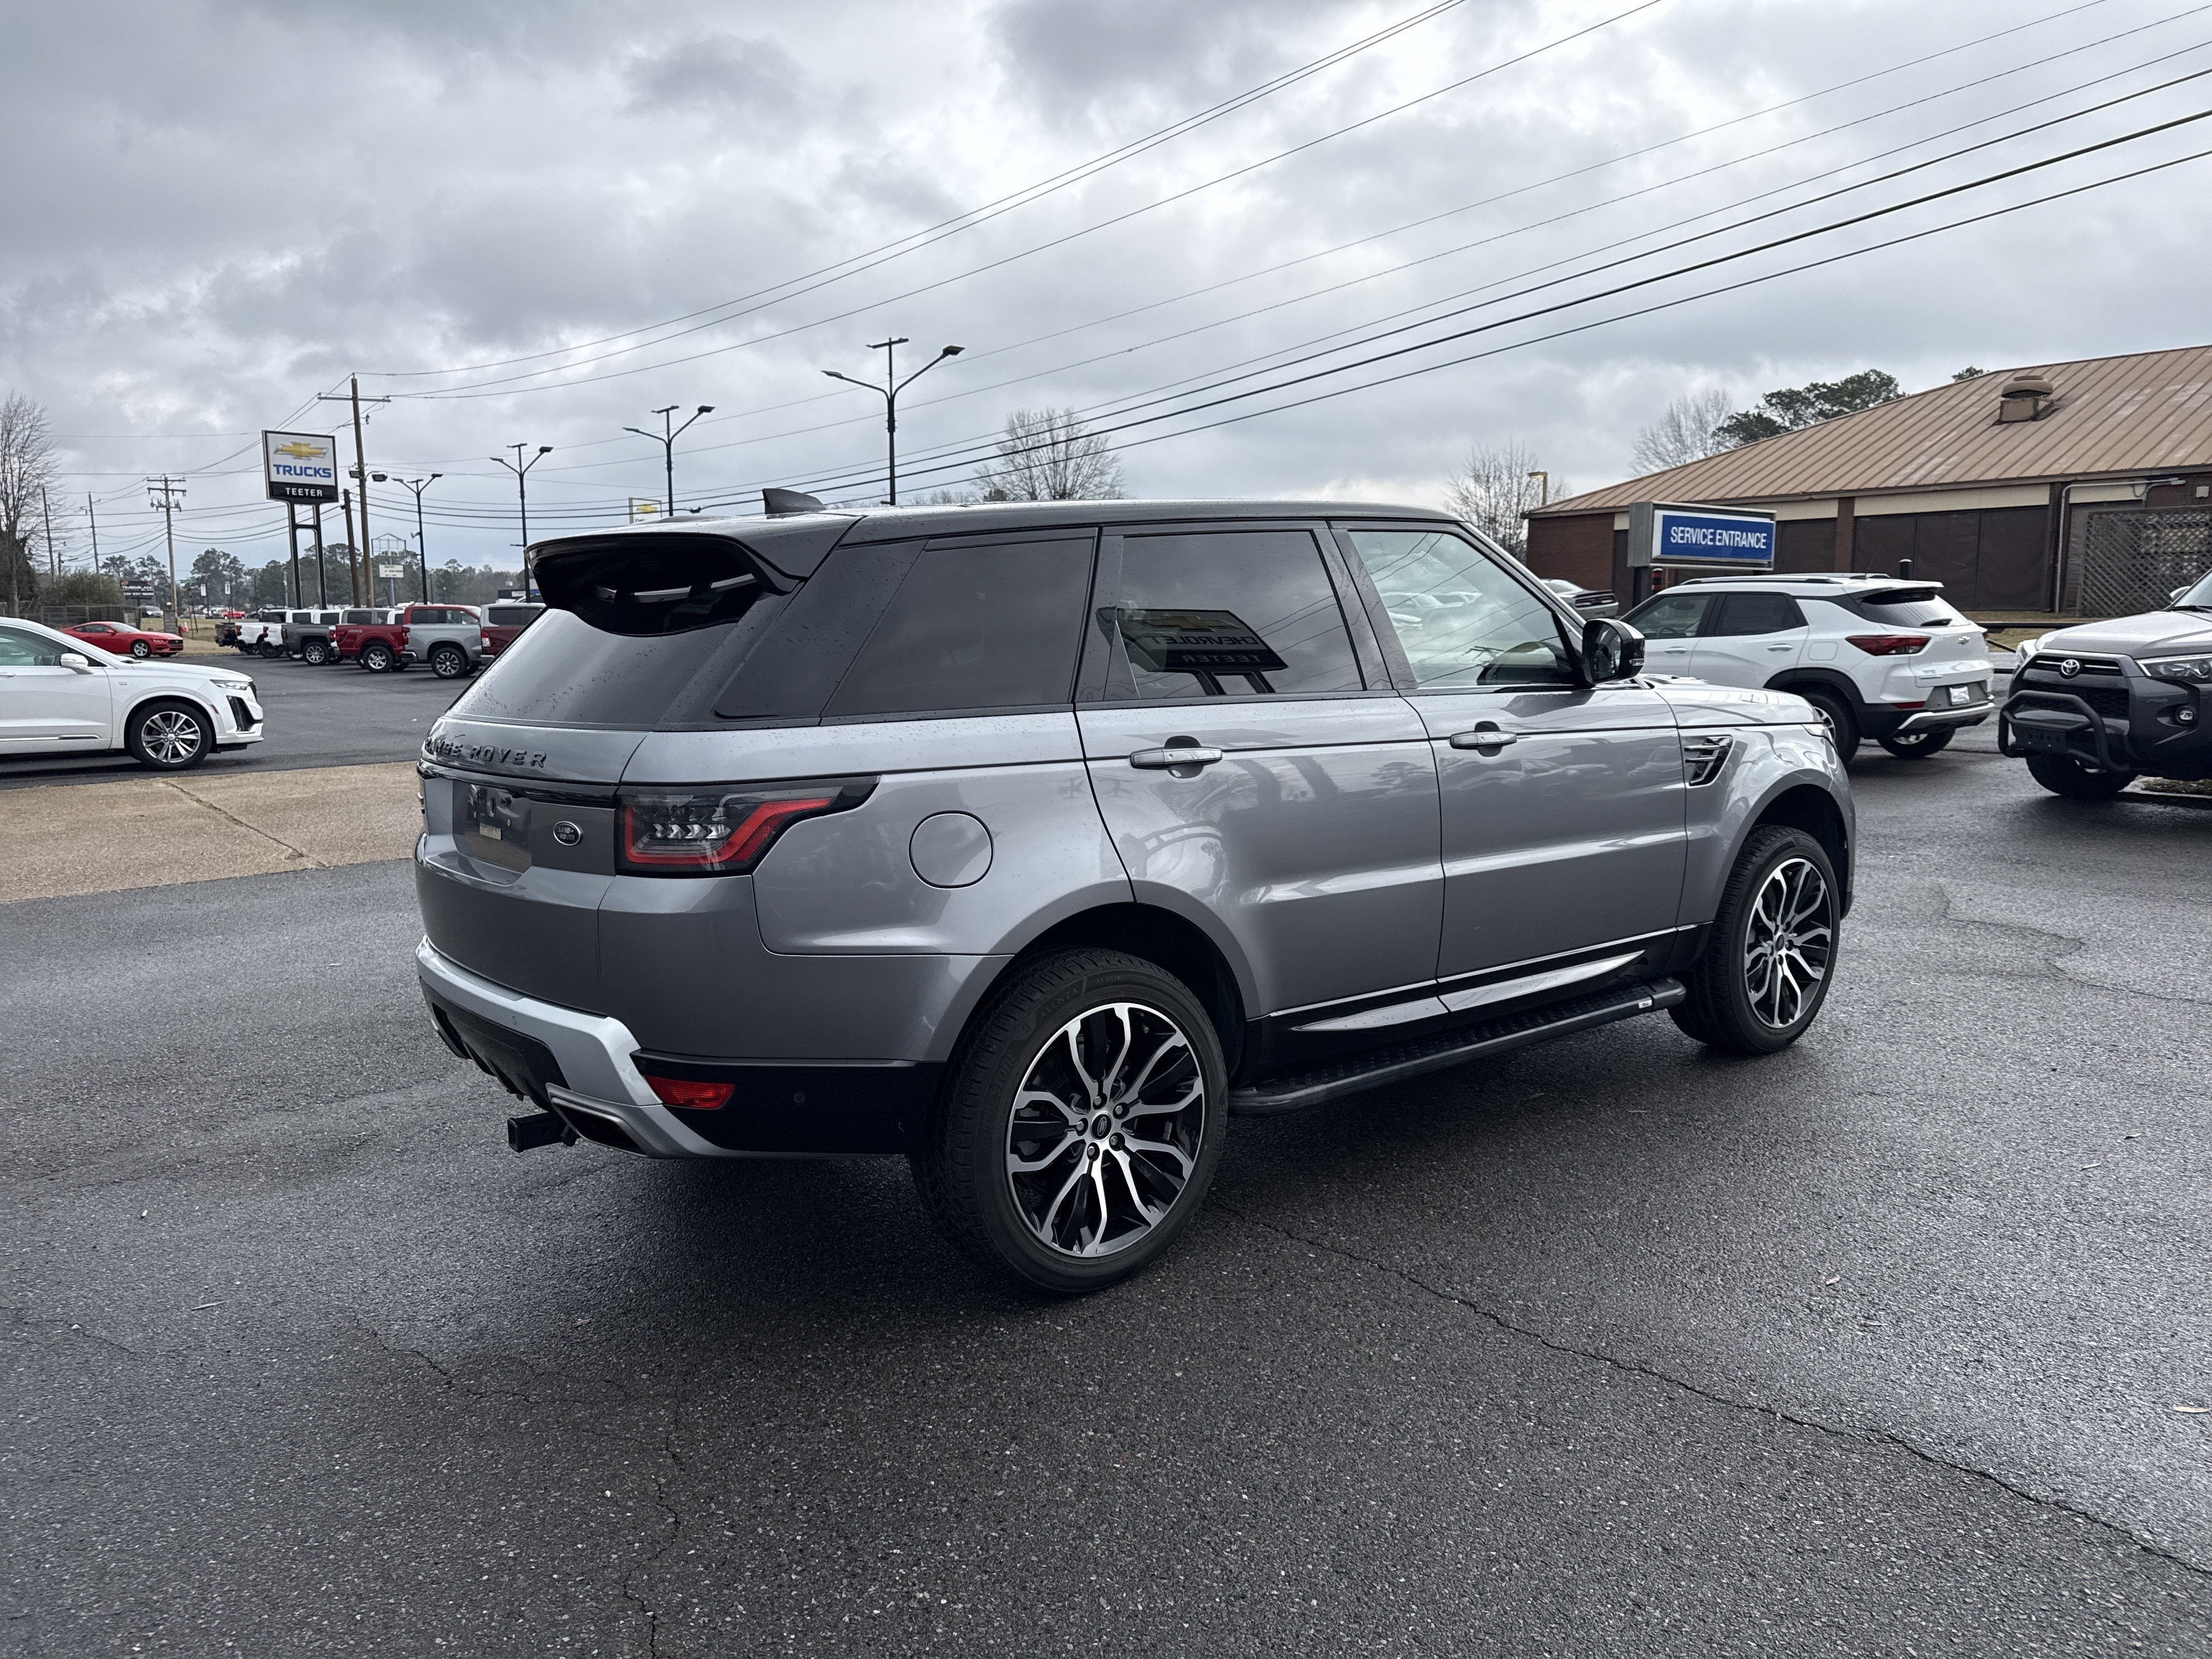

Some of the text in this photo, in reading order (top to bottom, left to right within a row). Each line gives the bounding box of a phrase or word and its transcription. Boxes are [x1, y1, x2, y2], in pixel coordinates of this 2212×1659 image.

[273, 464, 332, 478] TRUCKS
[285, 487, 323, 497] TEETER
[1670, 527, 1768, 549] SERVICE ENTRANCE
[470, 744, 547, 769] ROVER
